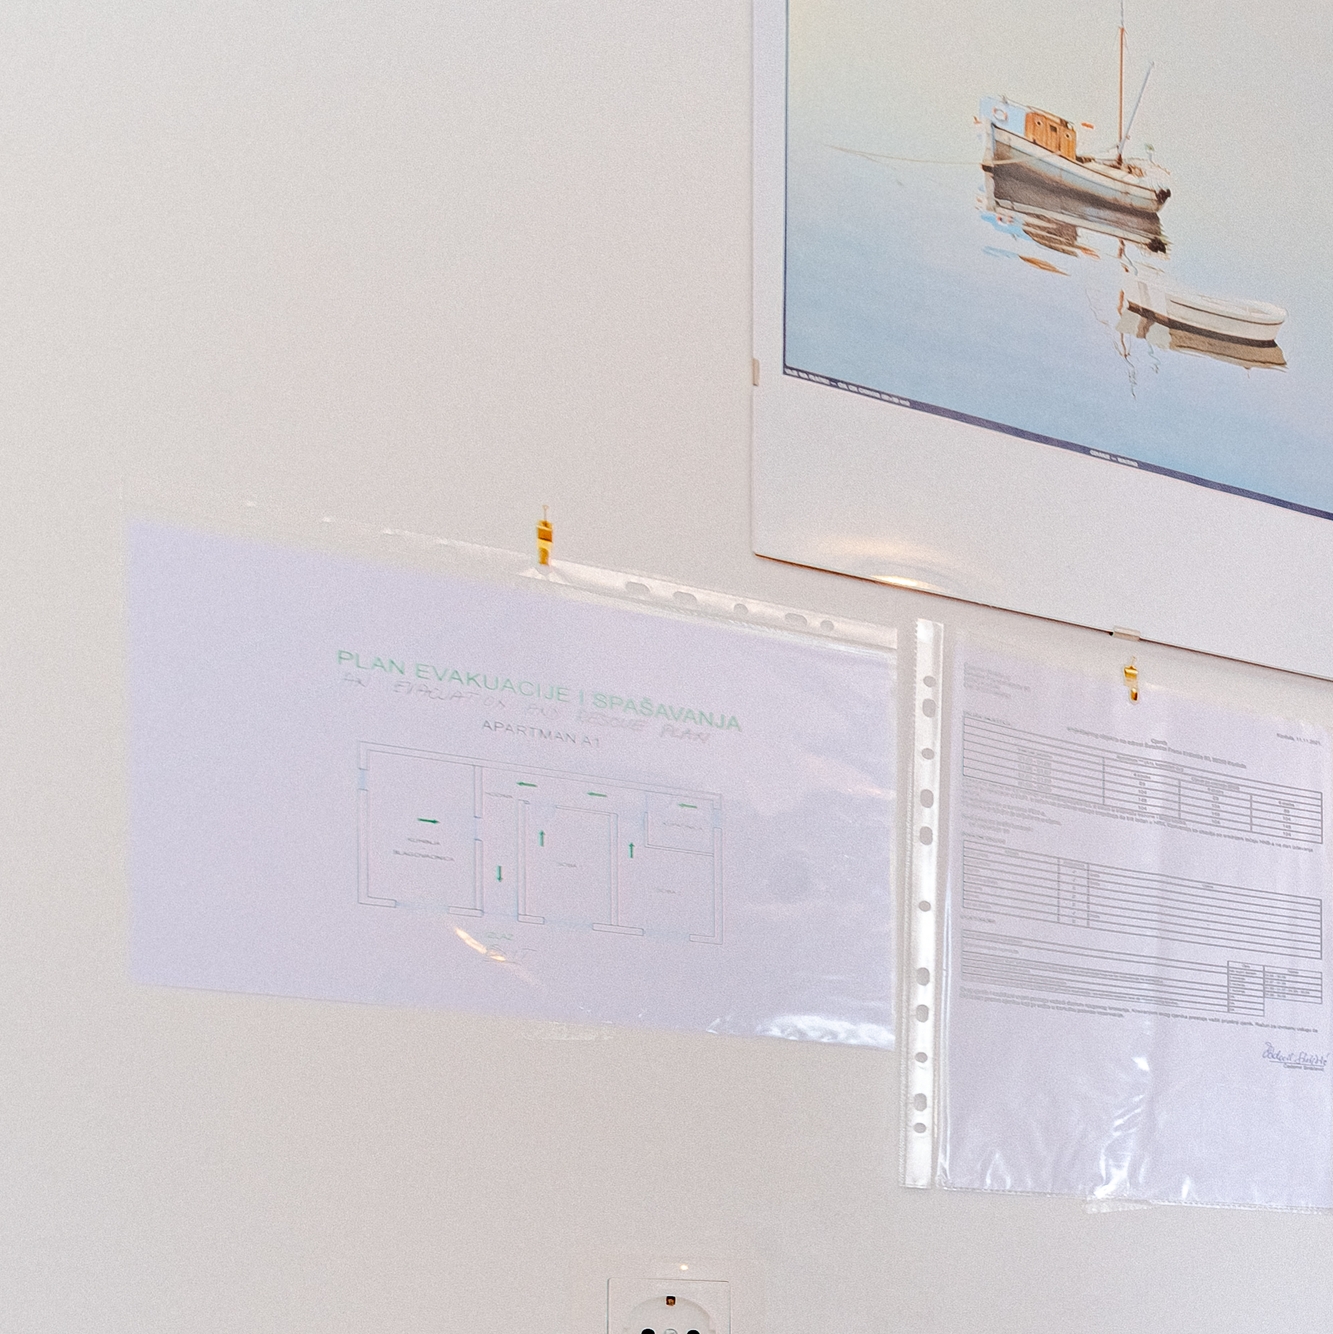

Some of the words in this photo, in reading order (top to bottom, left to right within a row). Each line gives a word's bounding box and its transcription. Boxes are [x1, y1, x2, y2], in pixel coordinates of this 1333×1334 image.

[336, 649, 406, 676] PLAN
[414, 663, 571, 703] EVAKUACIJE
[579, 690, 585, 706] I
[592, 692, 743, 733] SPAŠAVANJA
[481, 719, 577, 746] APARTMAN
